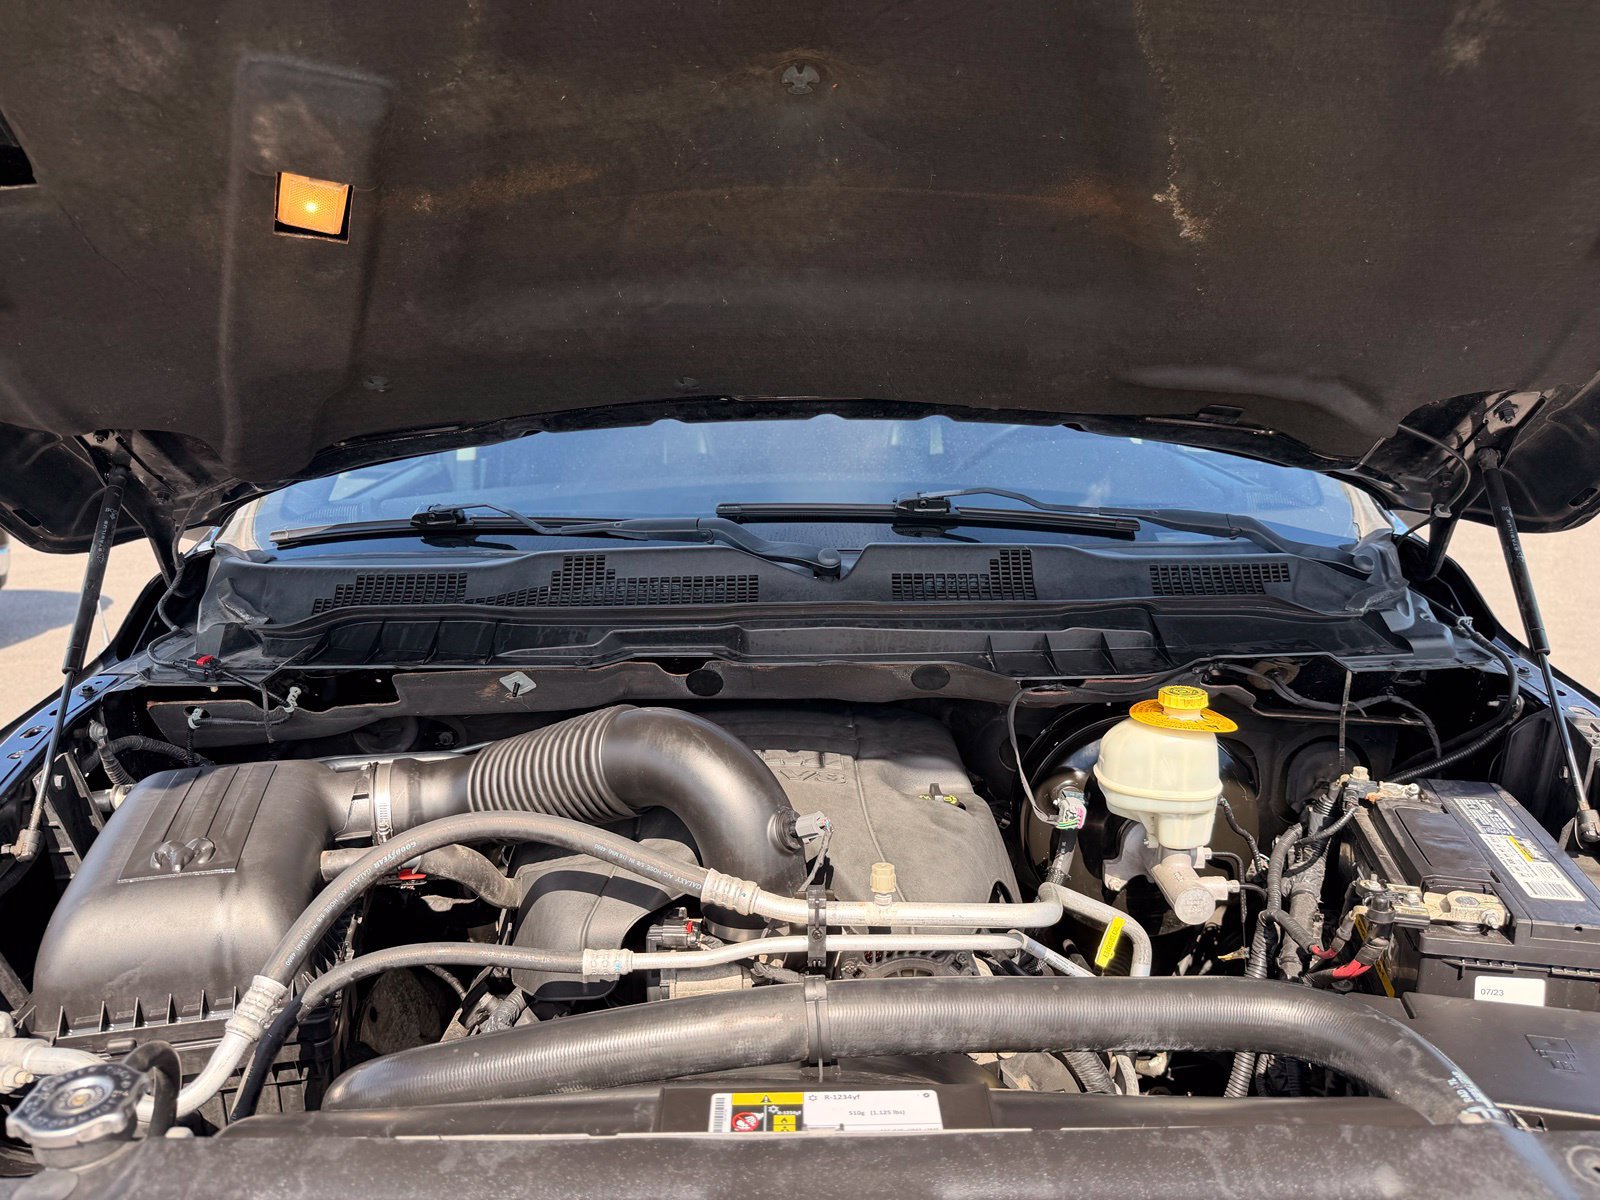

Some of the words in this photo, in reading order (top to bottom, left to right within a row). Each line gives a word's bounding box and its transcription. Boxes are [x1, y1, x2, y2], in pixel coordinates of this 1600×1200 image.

[374, 841, 417, 869] GOODYEAR
[349, 868, 373, 890] GALAXY
[675, 876, 702, 890] GALAXY
[324, 896, 339, 914] HOSE
[1480, 988, 1504, 997] 07/23
